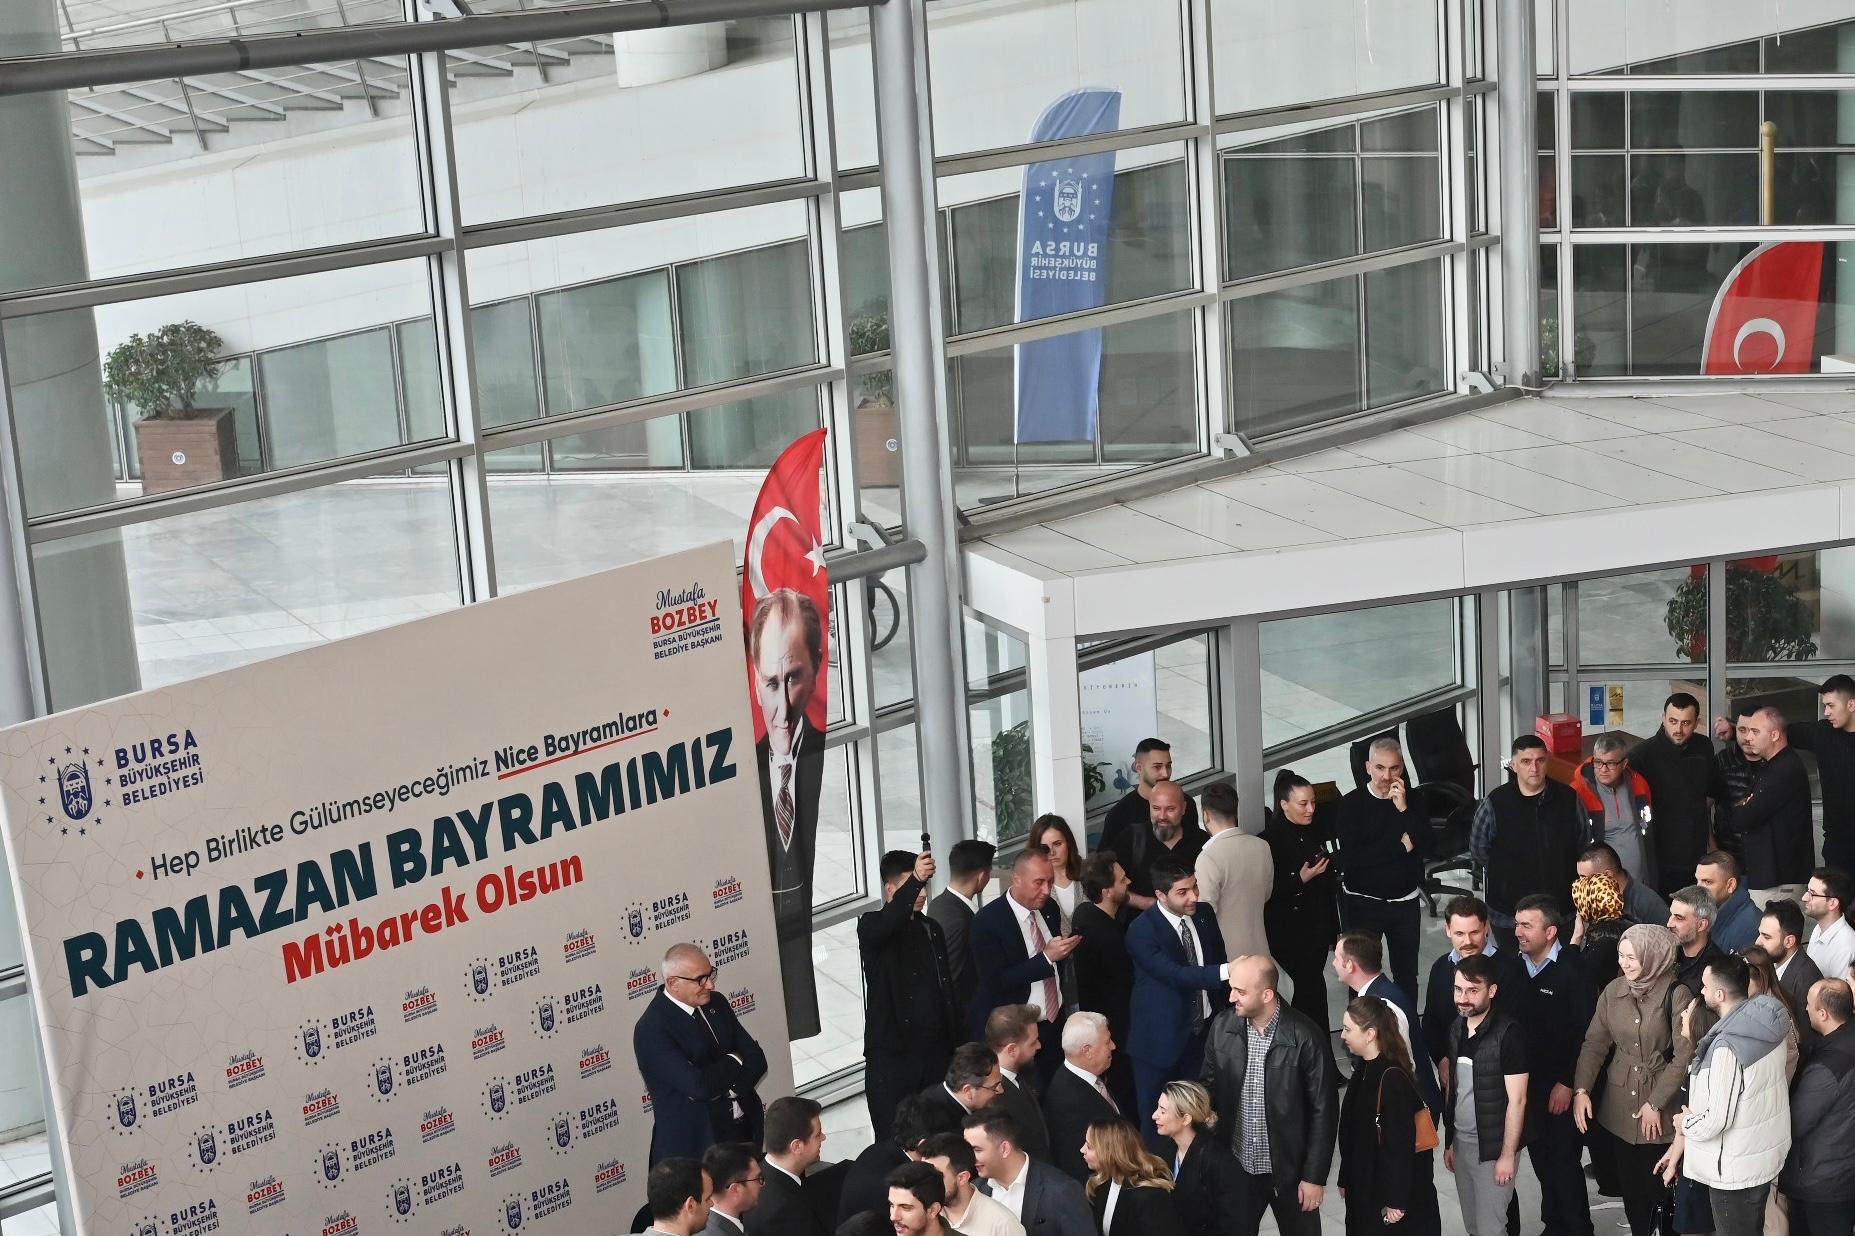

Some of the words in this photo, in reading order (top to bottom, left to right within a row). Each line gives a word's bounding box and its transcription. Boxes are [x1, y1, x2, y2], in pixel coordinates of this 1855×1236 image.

[656, 582, 705, 610] Mustafa
[650, 599, 718, 634] BOZBEY
[653, 636, 677, 649] BURSA
[678, 623, 721, 642] BÜYÜKŞEHİR
[654, 643, 689, 660] BELEDİYE
[690, 634, 722, 650] BAŞKANI
[114, 729, 197, 769] BURSA
[119, 751, 201, 787] BÜYÜKŞEHİR
[122, 768, 203, 806] BELEDİYESİ
[150, 850, 199, 880] Hep
[205, 824, 283, 863] Birlikte
[289, 757, 490, 835] Gülümseyeceğimiz
[494, 745, 538, 772] Nice
[543, 709, 658, 761] Bayramlara
[62, 841, 377, 998] RAMAZAN
[386, 726, 736, 889] BAYRAMIMIZ
[652, 891, 688, 912] BURSA
[712, 882, 741, 899] BOZBEY
[283, 886, 469, 983] Mübarek
[476, 855, 584, 913] Olsun
[563, 934, 594, 953] BOZBEY
[712, 929, 747, 949] BURSA
[498, 945, 537, 968] BURSA
[626, 971, 656, 989] BOZBEY
[402, 992, 436, 1012] BOZBEY
[564, 983, 601, 1005] BURSA
[730, 993, 754, 1009] OZBEY
[332, 1005, 373, 1029] BURSA
[471, 1030, 504, 1049] BOZBEY
[226, 1056, 264, 1077] BOZBEY
[403, 1043, 444, 1067] BURSA
[579, 1050, 609, 1069] BOZBEY
[148, 1071, 194, 1097] BURSA
[515, 1063, 553, 1086] BURSA
[302, 1094, 338, 1115] BOZBEY
[579, 1098, 616, 1121] BURSA
[227, 1109, 272, 1135] BURSA
[420, 1112, 454, 1132] BOZBEY
[350, 1127, 392, 1152] BURSA
[488, 1146, 520, 1167] BOZBEY
[117, 1164, 157, 1187] BOZBEY
[421, 1162, 461, 1187] BURSA
[594, 1163, 624, 1183] BOZBEY
[247, 1181, 284, 1203] BOZBEY
[531, 1178, 569, 1202] BURSA
[170, 1198, 216, 1225] BURSA
[321, 1216, 357, 1236] BOZBEY
